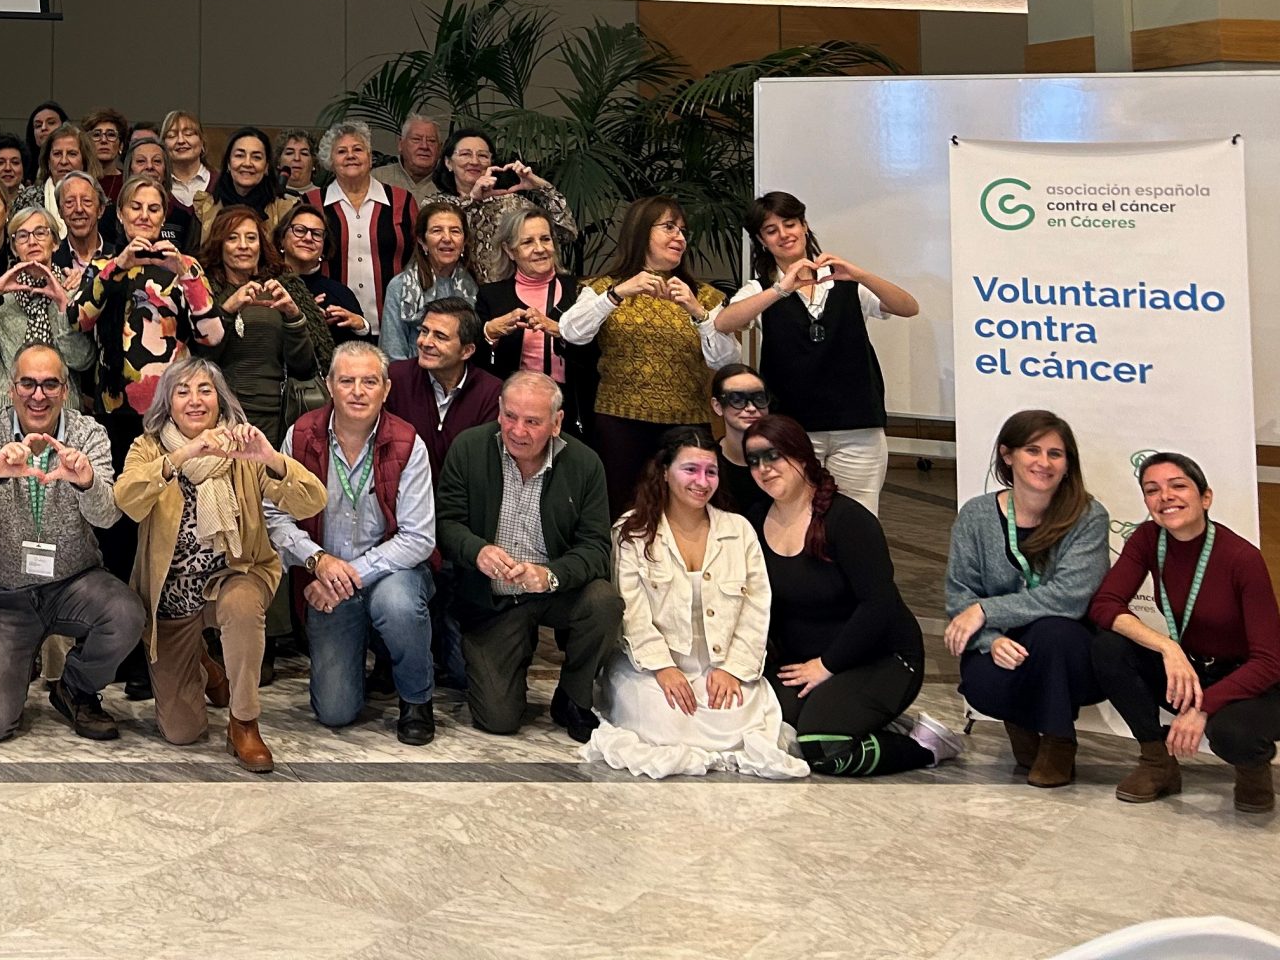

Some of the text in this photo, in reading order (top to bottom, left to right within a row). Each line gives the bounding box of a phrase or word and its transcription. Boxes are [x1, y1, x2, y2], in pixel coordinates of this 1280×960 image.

[1046, 184, 1211, 199] asociación española
[1047, 200, 1176, 213] contra el cáncer
[1047, 216, 1136, 229] en Cáceres
[972, 275, 1226, 312] Voluntariado
[974, 315, 1098, 344] contra
[975, 348, 1154, 384] el cáncer
